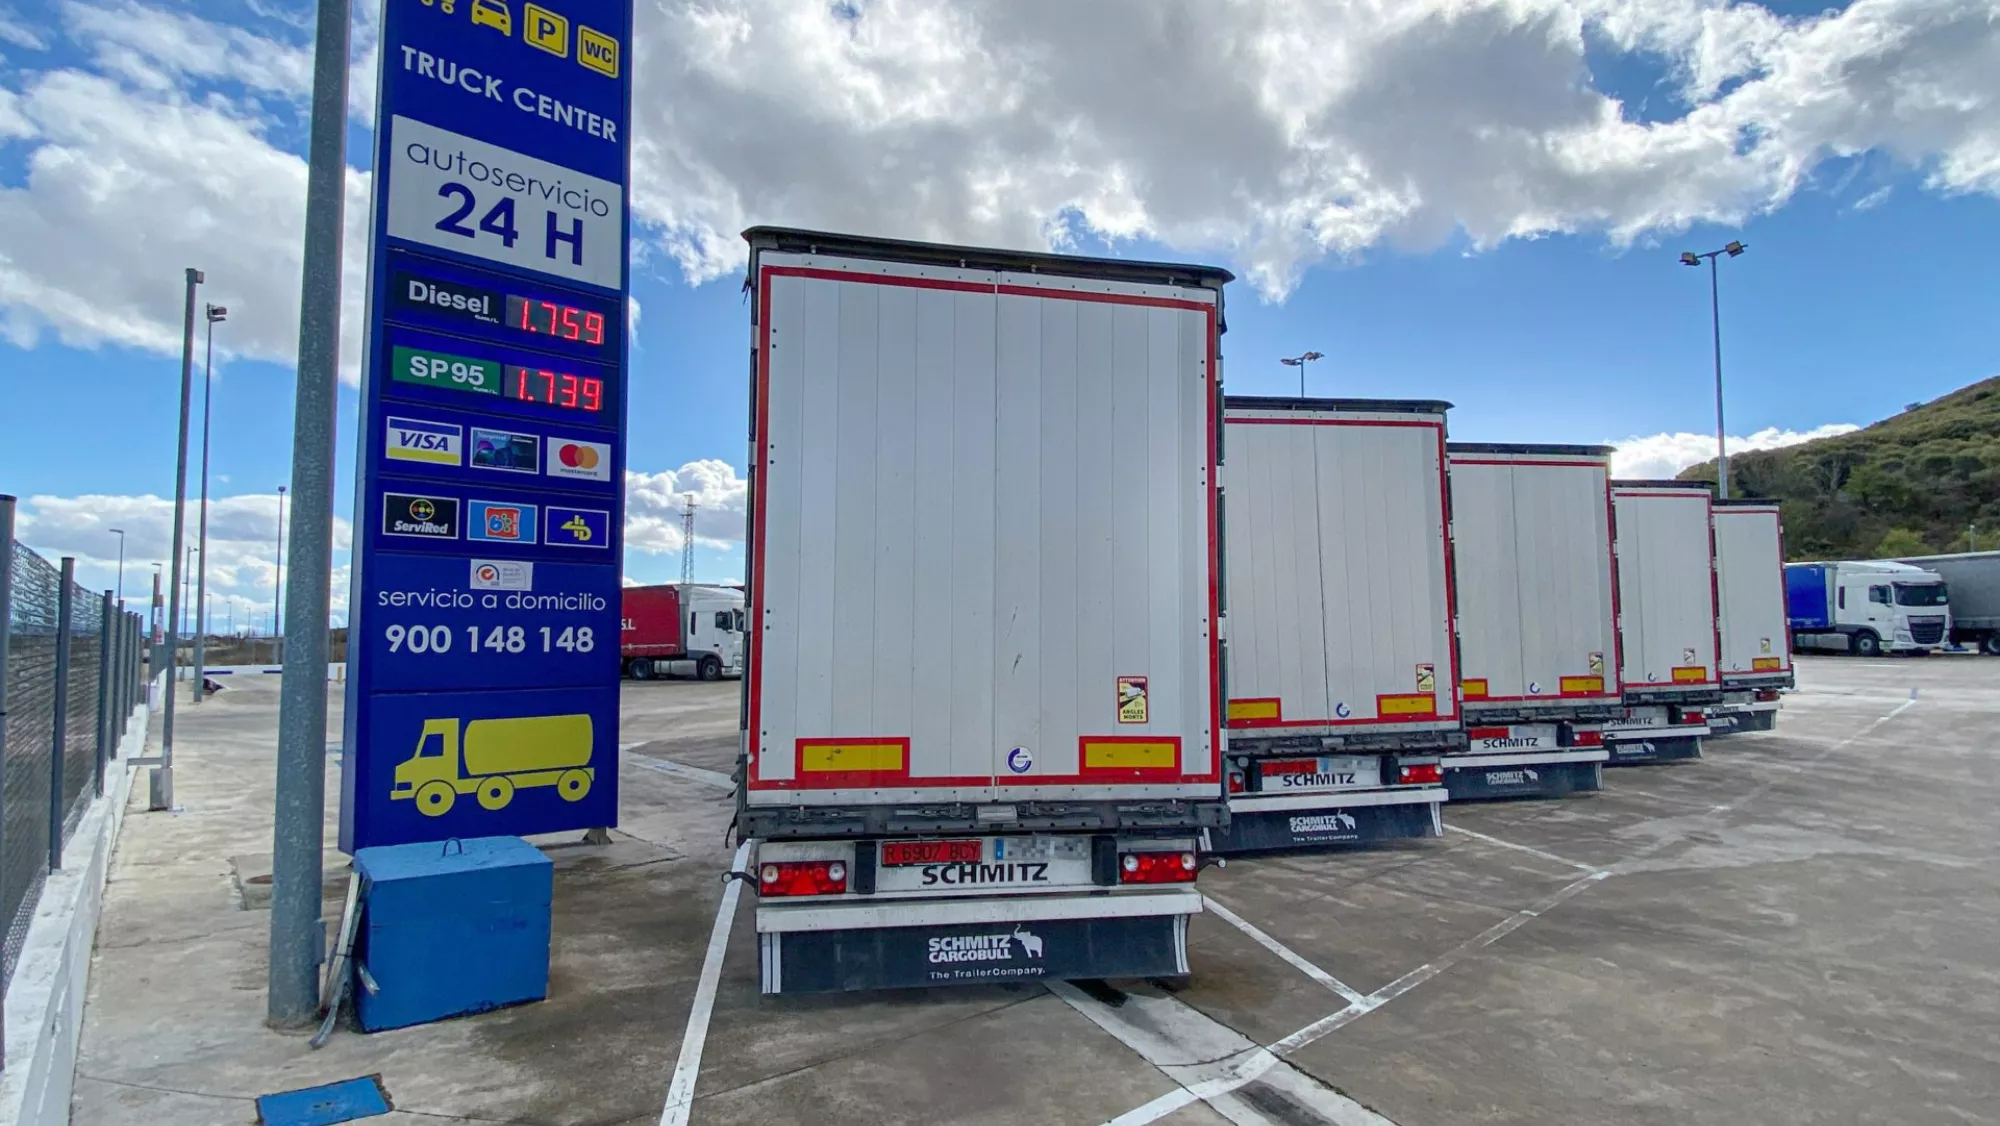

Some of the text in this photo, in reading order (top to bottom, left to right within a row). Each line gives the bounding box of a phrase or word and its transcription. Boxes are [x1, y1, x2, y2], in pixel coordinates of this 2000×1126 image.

[537, 19, 556, 41] P
[585, 39, 612, 64] WC
[401, 45, 617, 142] TRUCK CENTER
[407, 143, 609, 217] autoservicio
[435, 182, 583, 266] 24 H
[408, 280, 489, 315] Diesel
[521, 300, 604, 345] 1.759
[409, 356, 485, 386] SP95
[519, 369, 600, 411] 1.739
[399, 431, 449, 452] VISA
[394, 520, 449, 535] ServiRed
[378, 588, 606, 611] servicio a domicilio
[385, 624, 595, 654] 900 148 148
[1483, 737, 1538, 749] SCHMITZ
[1282, 773, 1355, 787] SCHMITZ
[1289, 815, 1337, 826] SCHMITZ
[921, 863, 1049, 885] SCHMITZ
[929, 934, 1011, 952] SCHMITZ
[929, 948, 1012, 963] CARGOBULL
[930, 971, 950, 980] The
